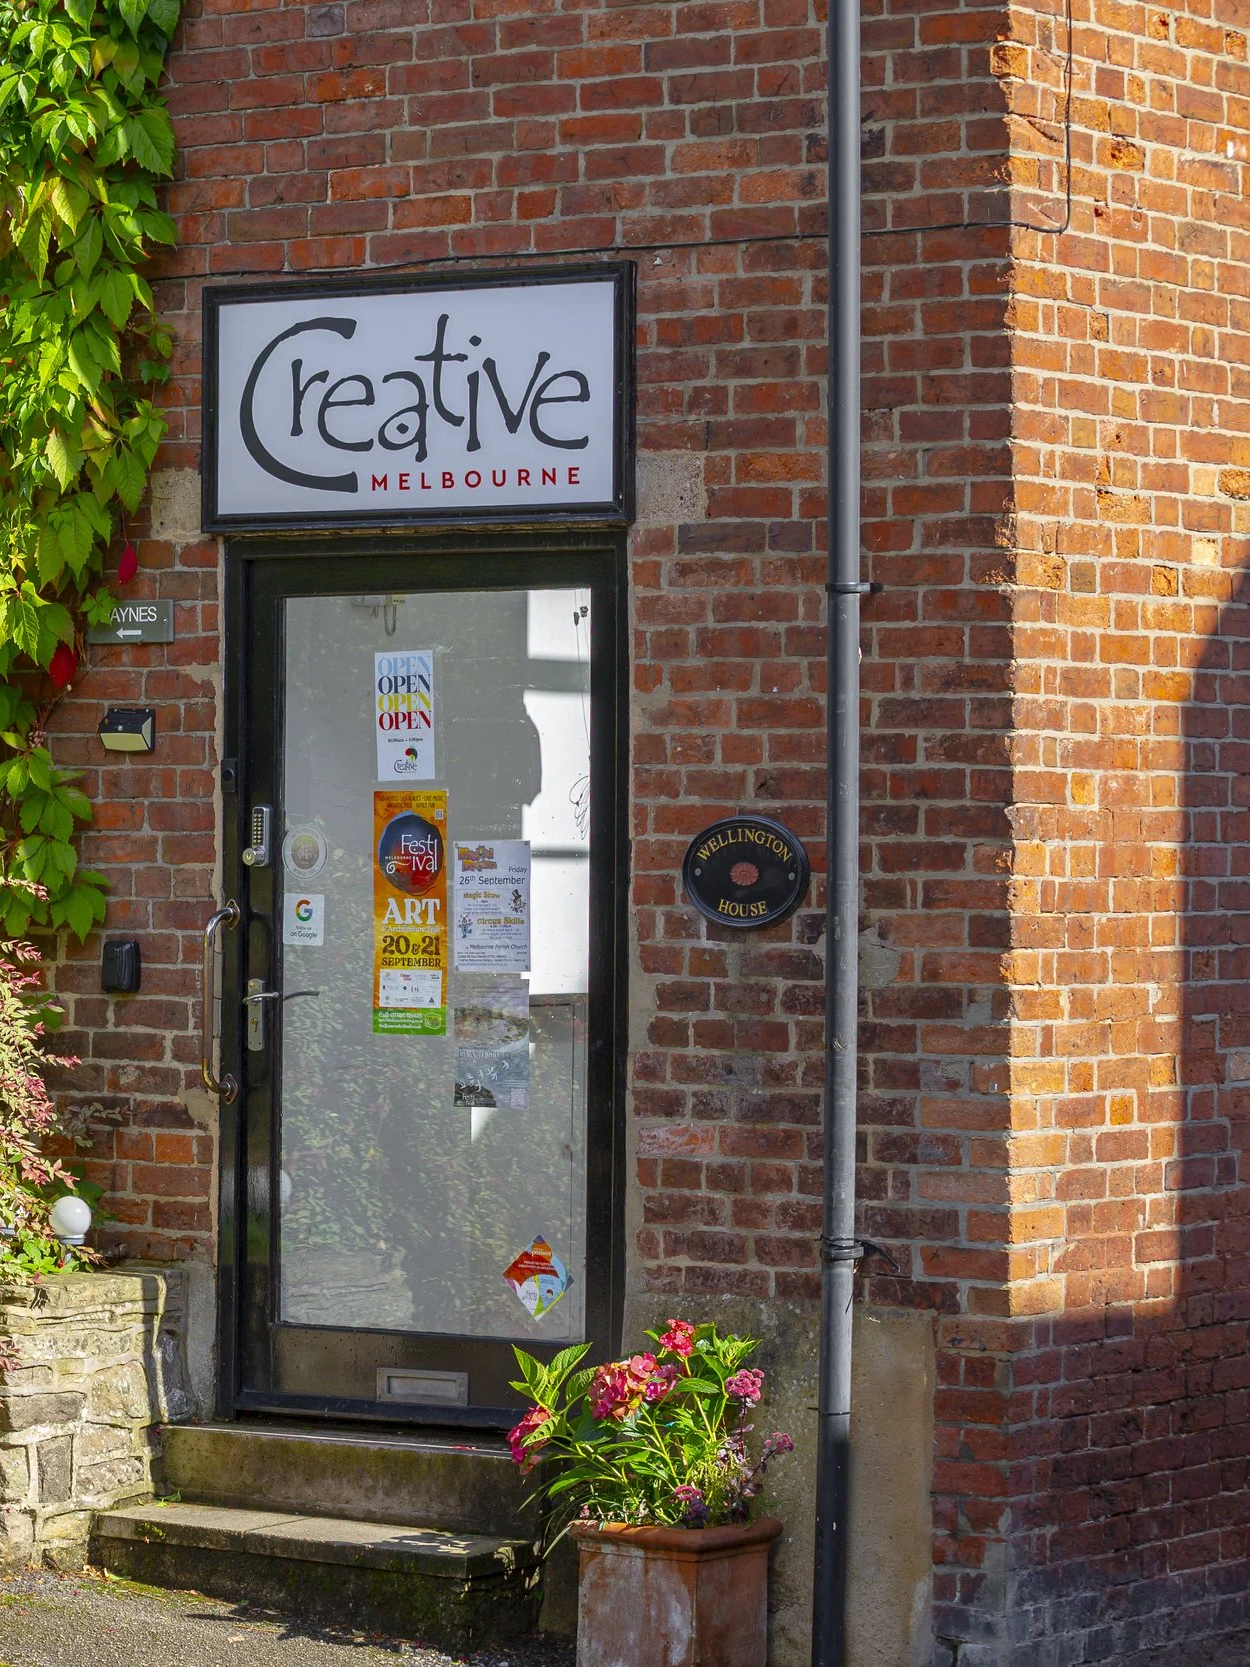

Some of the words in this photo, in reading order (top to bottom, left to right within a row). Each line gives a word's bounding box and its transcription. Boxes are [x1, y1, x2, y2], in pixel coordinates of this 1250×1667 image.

[240, 314, 591, 493] Creative
[371, 467, 581, 491] MELBOURNE
[107, 606, 157, 623] AYNES
[378, 656, 431, 675] OPEN
[378, 674, 431, 694] OPEN
[378, 693, 431, 712] OPEN
[378, 711, 431, 731] OPEN
[697, 828, 793, 862] WELLINGTON
[459, 876, 476, 885] 26th
[478, 876, 525, 885] September
[382, 898, 441, 925] ART
[717, 899, 768, 917] HOUSE
[298, 931, 317, 939] Google
[381, 956, 442, 967] SEPTEMBER
